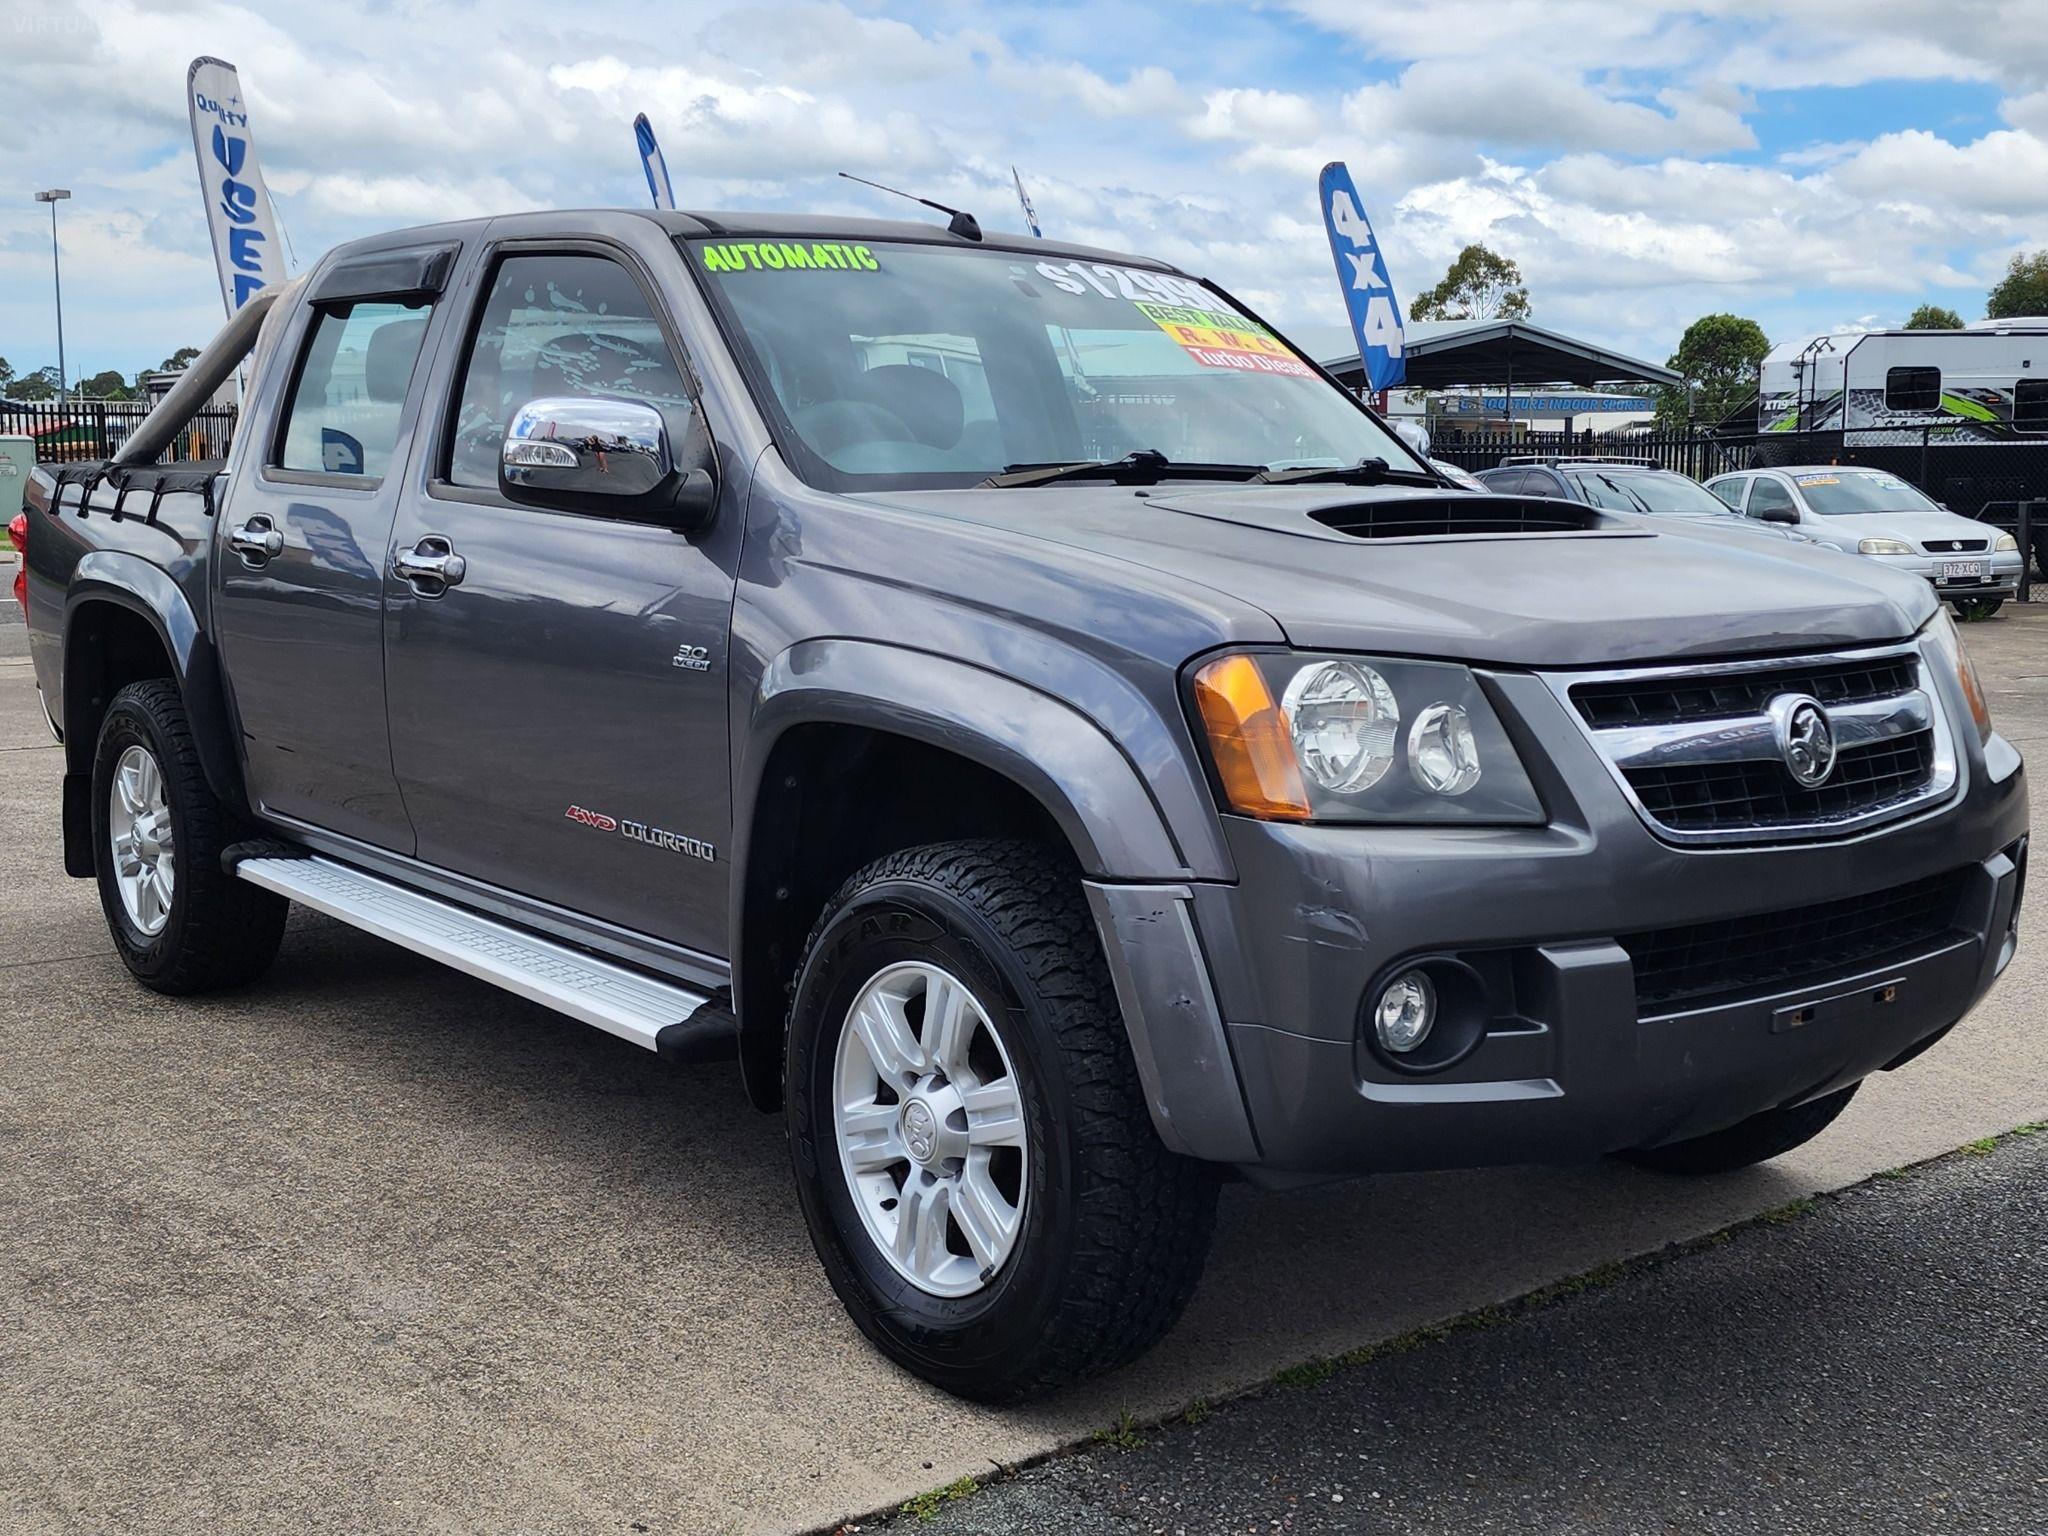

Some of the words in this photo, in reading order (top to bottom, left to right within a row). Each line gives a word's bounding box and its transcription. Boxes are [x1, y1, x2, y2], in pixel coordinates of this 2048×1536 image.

[702, 243, 880, 272] AUTOMATIC
[1142, 303, 1203, 326] BEST
[1206, 312, 1276, 338] VALUE
[1187, 346, 1255, 370] Turbo
[1252, 352, 1318, 379] Diesel
[1550, 398, 1598, 410] INDOOR
[1602, 399, 1646, 411] SPORTS
[565, 805, 618, 832] 4WD
[621, 819, 716, 863] COLORADO
